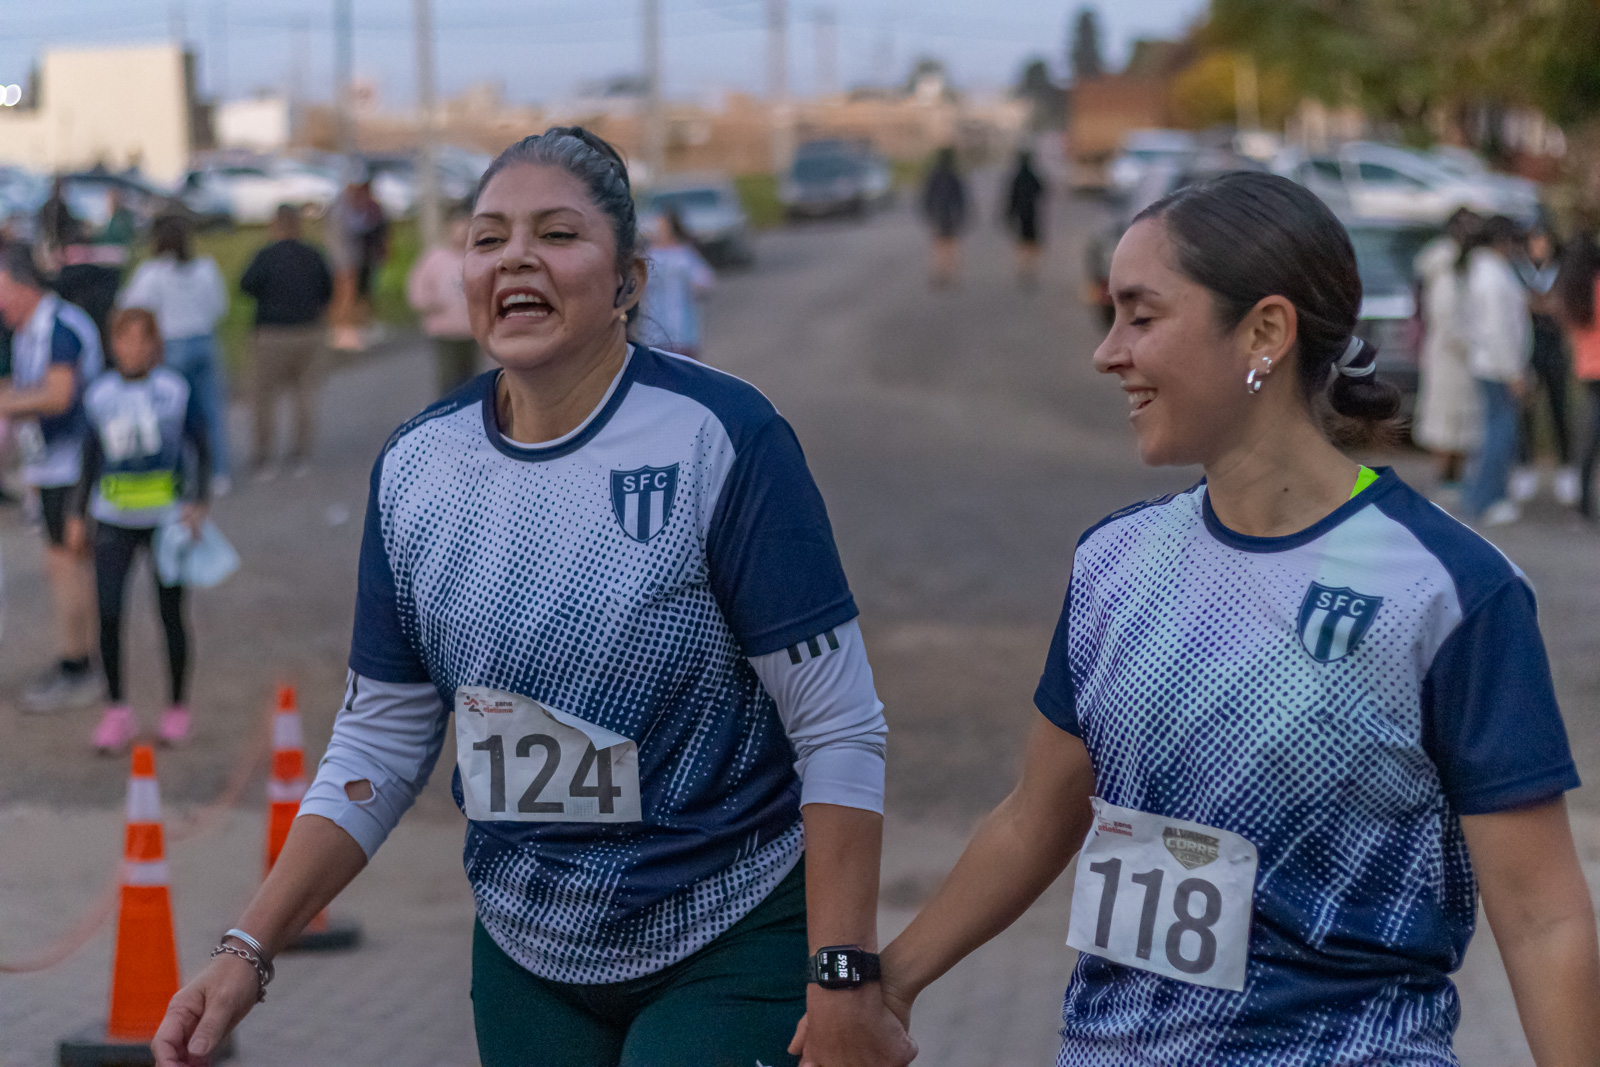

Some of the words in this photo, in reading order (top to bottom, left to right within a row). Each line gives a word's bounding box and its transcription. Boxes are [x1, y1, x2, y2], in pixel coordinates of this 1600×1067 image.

[622, 471, 668, 492] SFC
[1316, 591, 1366, 616] SFC
[473, 733, 622, 814] 124
[1113, 820, 1132, 830] zona
[1165, 838, 1218, 858] CORRE
[1089, 857, 1223, 975] 118
[837, 954, 849, 978] 59:18
